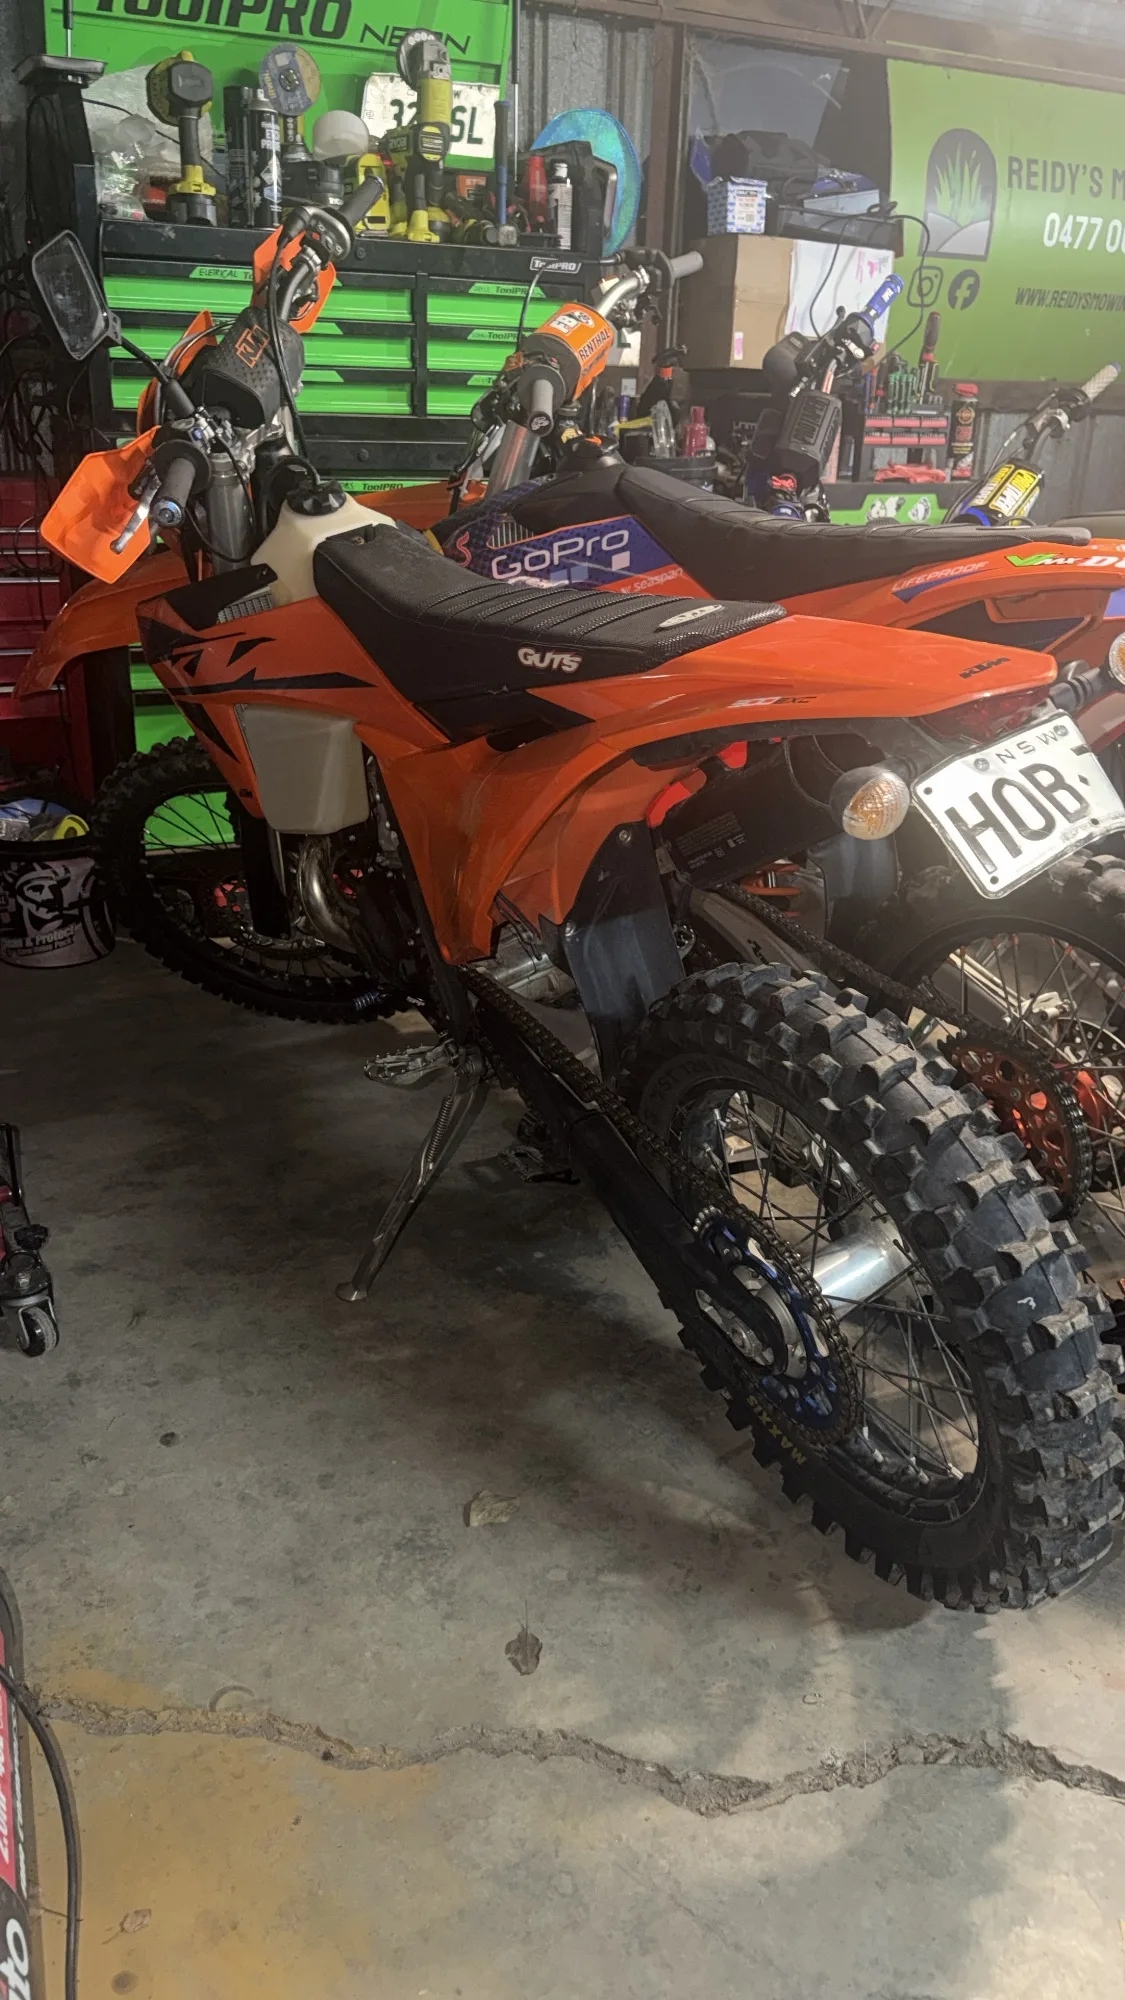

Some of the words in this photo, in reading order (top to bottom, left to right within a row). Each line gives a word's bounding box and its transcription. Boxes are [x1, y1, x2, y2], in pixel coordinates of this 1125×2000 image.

[360, 23, 471, 55] NEN
[1007, 155, 1103, 198] REIDY'S
[1043, 212, 1103, 250] 0477
[495, 286, 528, 295] ToolPR
[487, 331, 519, 340] ToolPR
[579, 327, 610, 362] RENTHAL
[362, 483, 404, 491] ToolPRO
[491, 529, 630, 580] GoPro
[633, 566, 684, 593] seaspan
[892, 560, 990, 592] LIFEPROOF
[517, 647, 583, 673] GUTS
[959, 657, 1011, 679] KTM
[746, 1395, 808, 1466] MAXXIS
